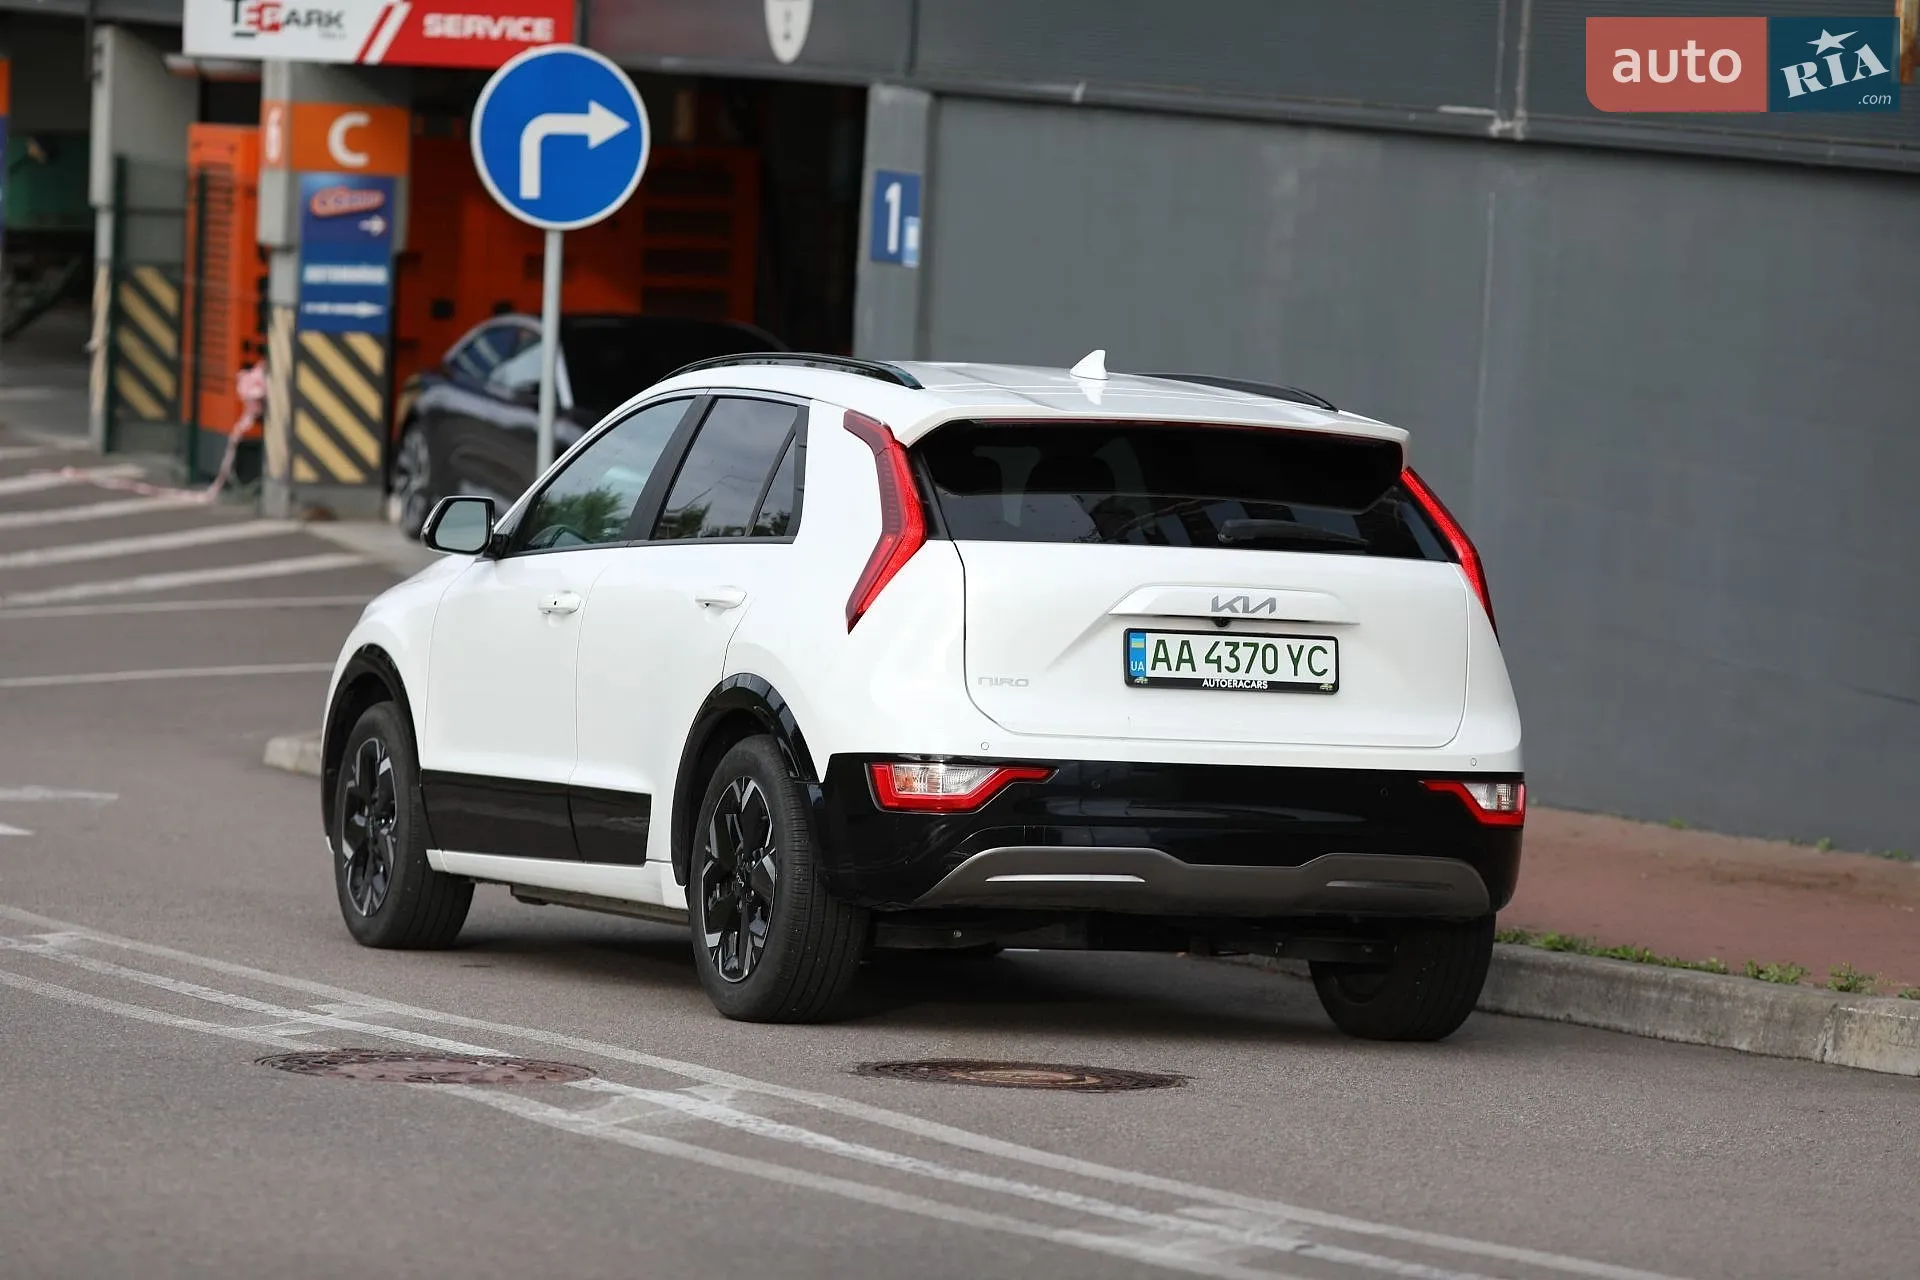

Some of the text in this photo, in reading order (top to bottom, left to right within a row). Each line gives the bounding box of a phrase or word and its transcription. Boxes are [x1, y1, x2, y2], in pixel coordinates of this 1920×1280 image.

[422, 12, 555, 42] SERVICE
[327, 111, 371, 167] C
[885, 181, 902, 255] 1
[1210, 595, 1277, 614] KIA
[1130, 661, 1145, 672] UA
[1150, 639, 1328, 677] AA 4370 YC
[977, 676, 1030, 688] NIRO
[1202, 677, 1268, 690] AUTOERACARS
